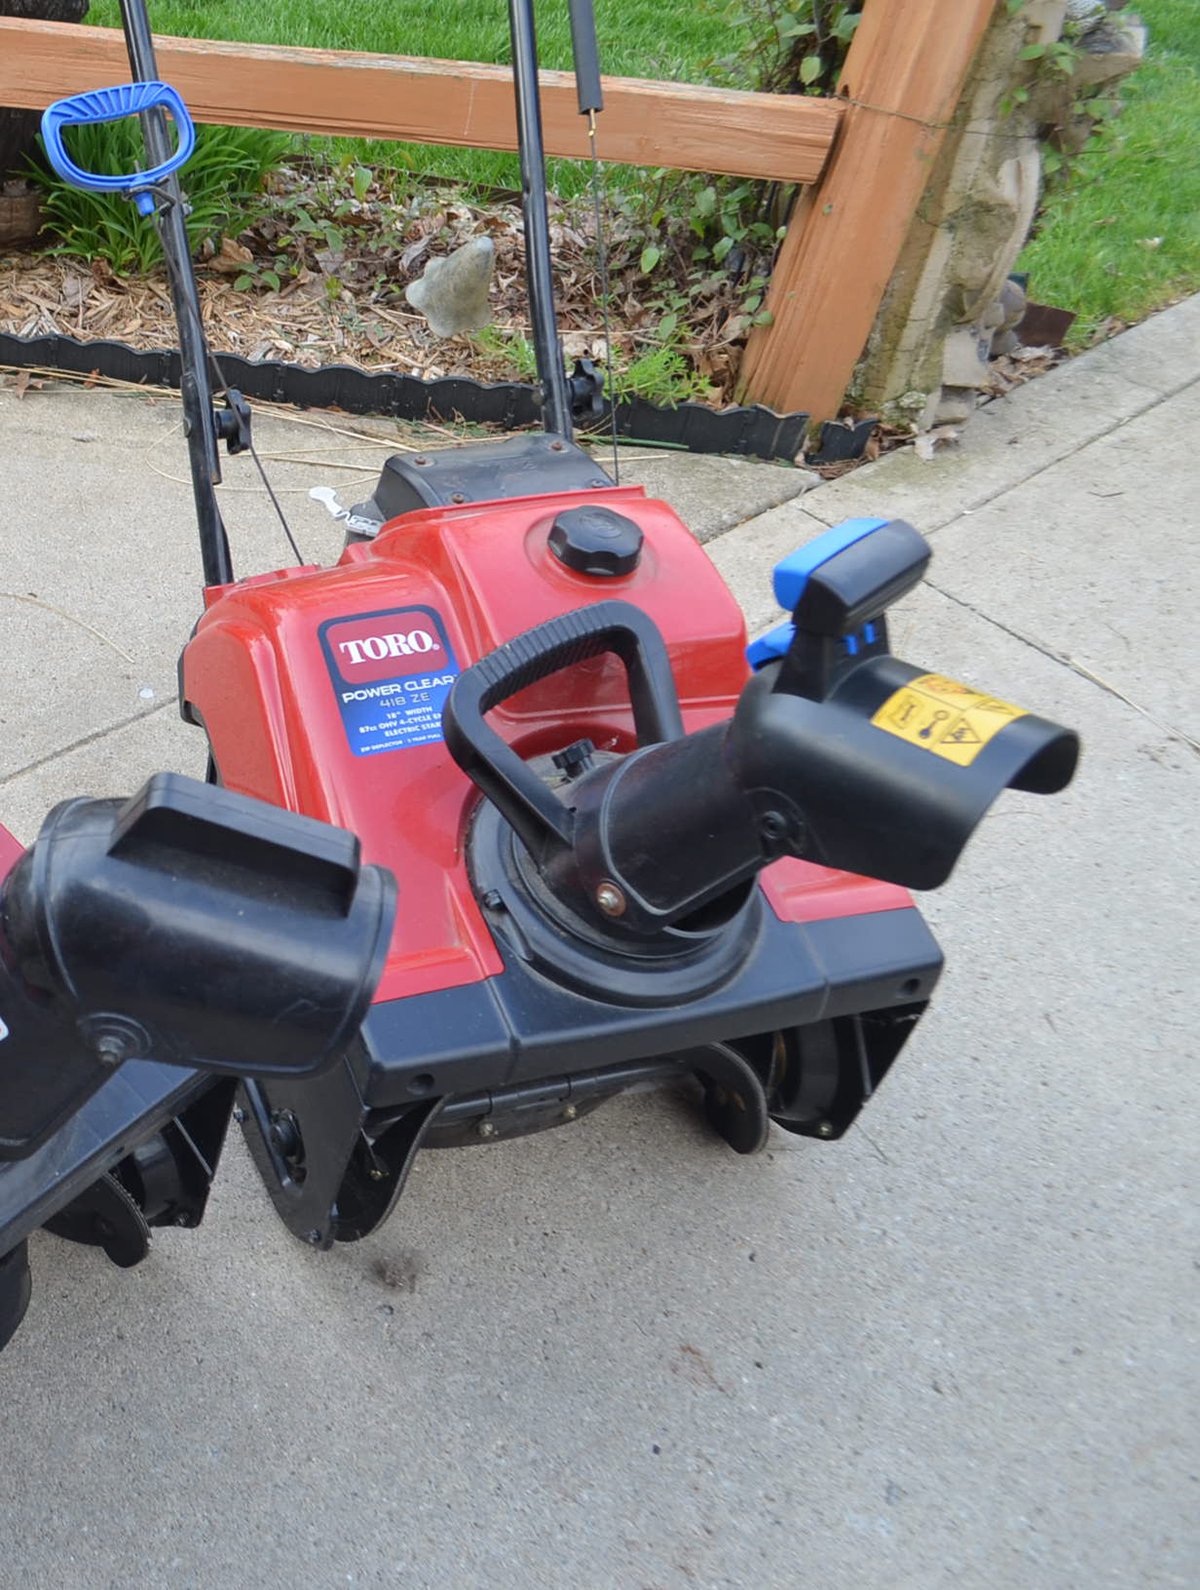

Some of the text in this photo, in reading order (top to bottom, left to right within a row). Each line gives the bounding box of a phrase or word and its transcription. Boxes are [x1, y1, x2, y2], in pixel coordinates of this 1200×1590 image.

[339, 630, 433, 664] TORO
[342, 675, 455, 703] POWER CLEAR
[380, 692, 430, 707] 418 ZE
[405, 706, 433, 715] WIDTH
[384, 725, 421, 737] ELECTRIC
